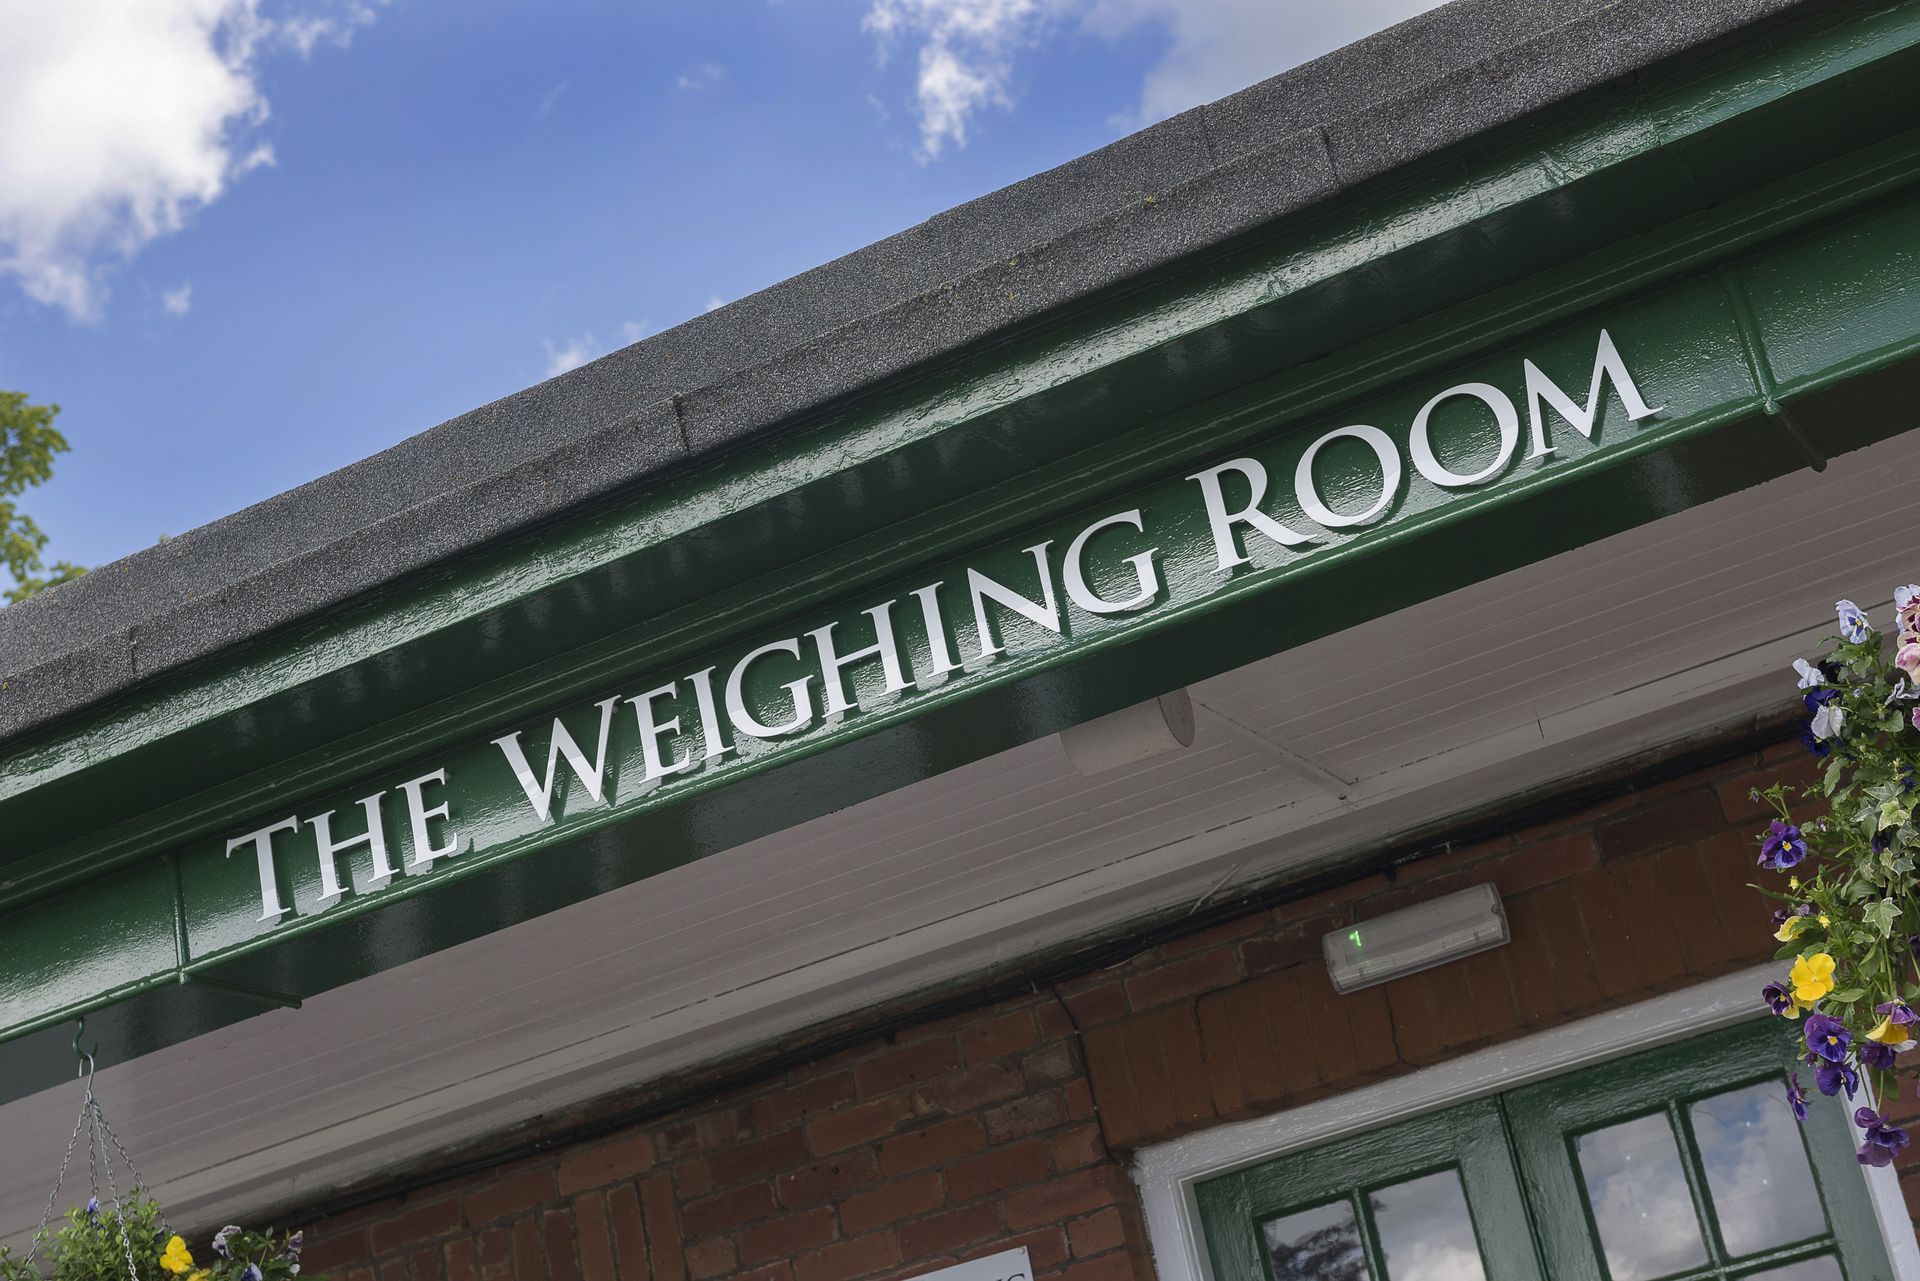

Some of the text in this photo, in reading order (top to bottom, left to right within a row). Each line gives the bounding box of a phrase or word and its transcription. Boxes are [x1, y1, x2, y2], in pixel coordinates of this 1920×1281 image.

[226, 328, 1665, 922] THE WEIGHING ROOM
